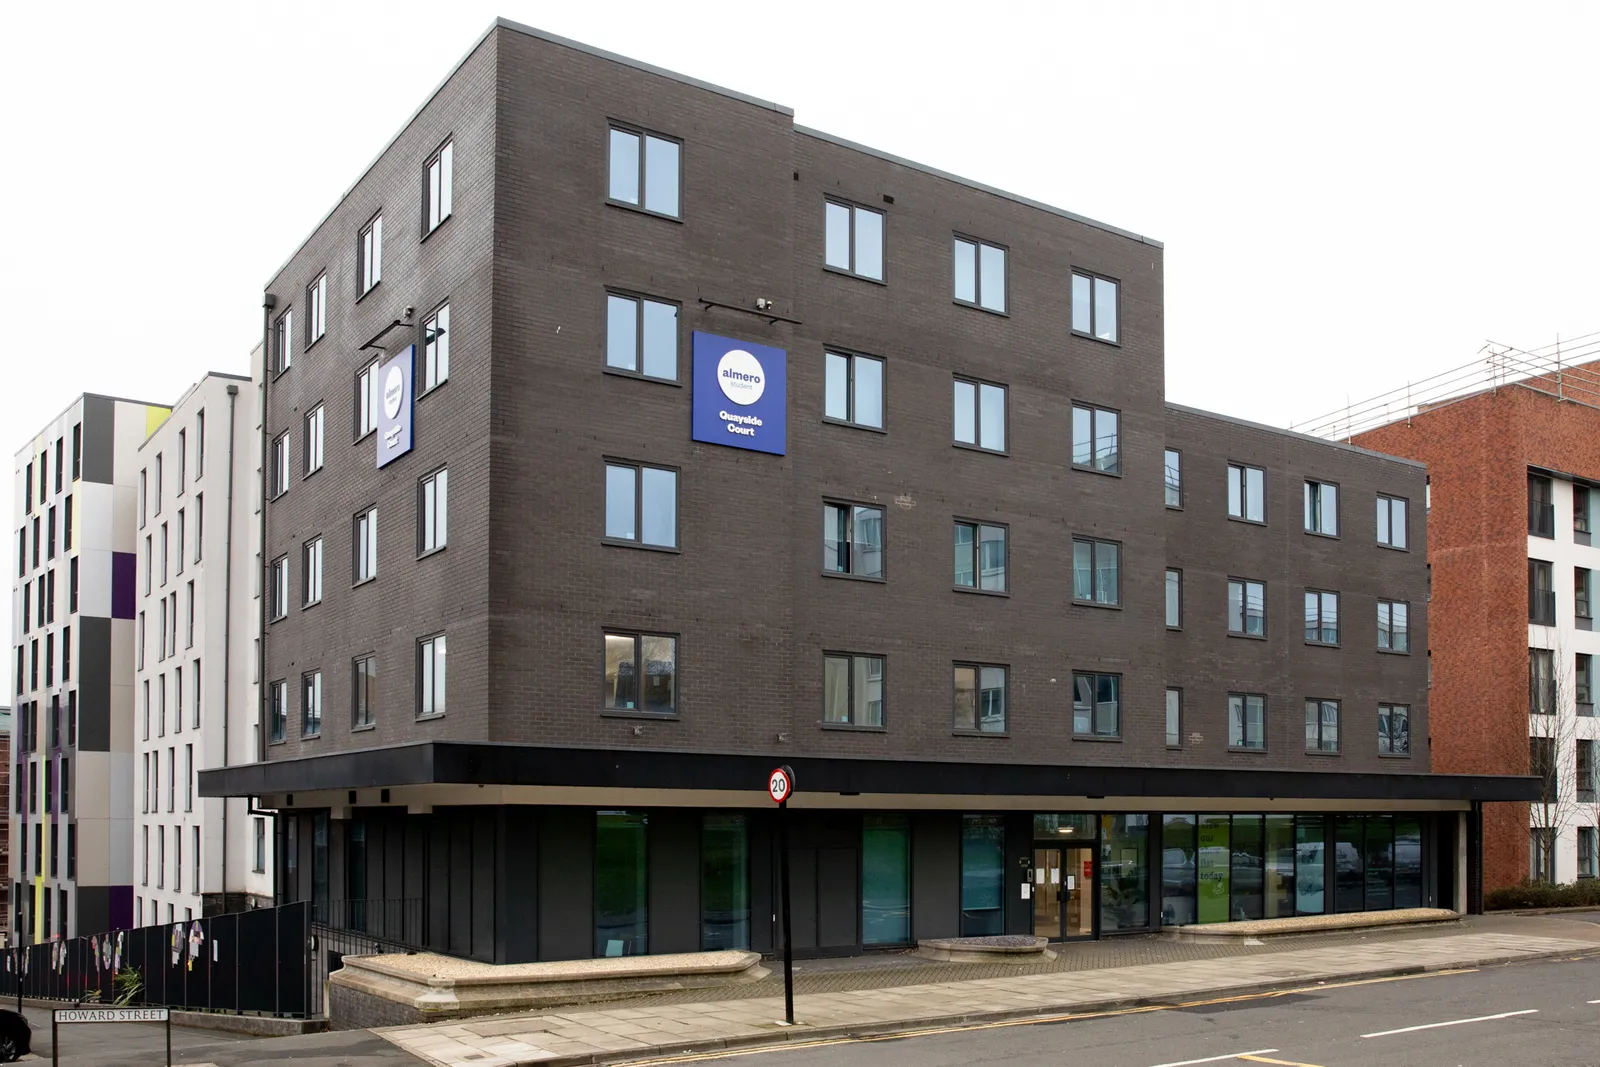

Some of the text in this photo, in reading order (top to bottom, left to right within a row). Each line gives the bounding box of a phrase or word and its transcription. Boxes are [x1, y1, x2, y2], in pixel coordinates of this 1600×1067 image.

[722, 368, 761, 384] almero
[730, 382, 753, 390] student
[719, 410, 763, 427] Quayside
[727, 423, 755, 436] Court
[772, 778, 785, 792] 20
[1200, 871, 1223, 882] today
[59, 1010, 164, 1021] HOWARD STREET
